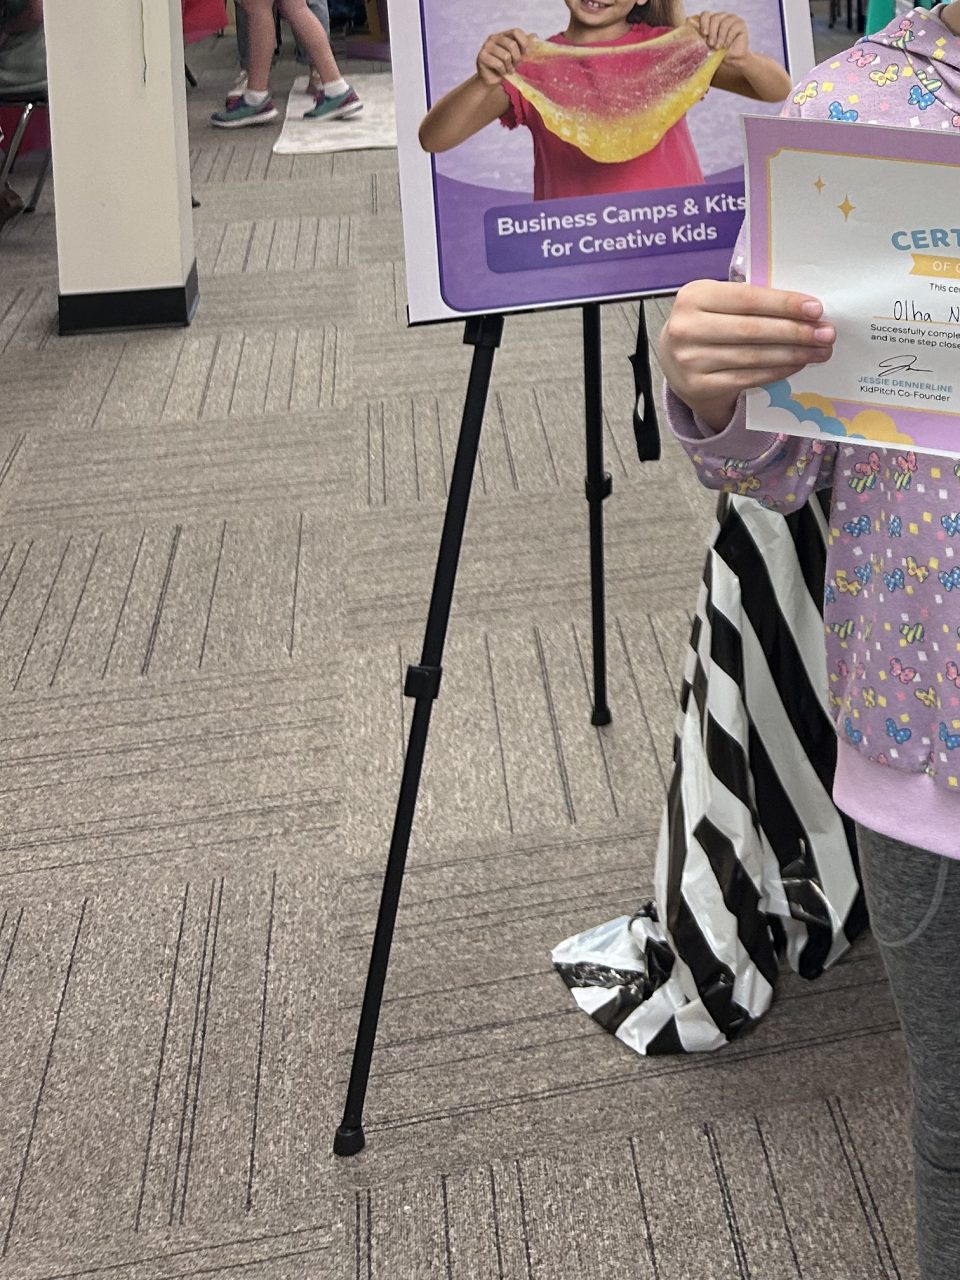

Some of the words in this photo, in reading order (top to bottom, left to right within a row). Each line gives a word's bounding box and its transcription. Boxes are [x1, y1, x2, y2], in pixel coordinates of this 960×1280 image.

[497, 213, 597, 236] Business
[602, 203, 677, 224] Camps
[683, 198, 700, 216] &
[705, 194, 746, 214] Kits
[541, 239, 574, 257] for
[579, 229, 667, 252] Creative
[671, 224, 718, 244] Kids
[932, 260, 951, 272] OF
[929, 282, 946, 293] This
[893, 299, 933, 323] Olha
[870, 323, 925, 337] Successfully
[870, 334, 888, 342] and
[898, 337, 916, 345] one
[917, 339, 937, 347] step
[857, 376, 890, 386] JESSIE
[892, 379, 953, 393] DENNERLINE
[860, 385, 896, 396] KidPitch
[897, 389, 952, 402] Co-Founder
